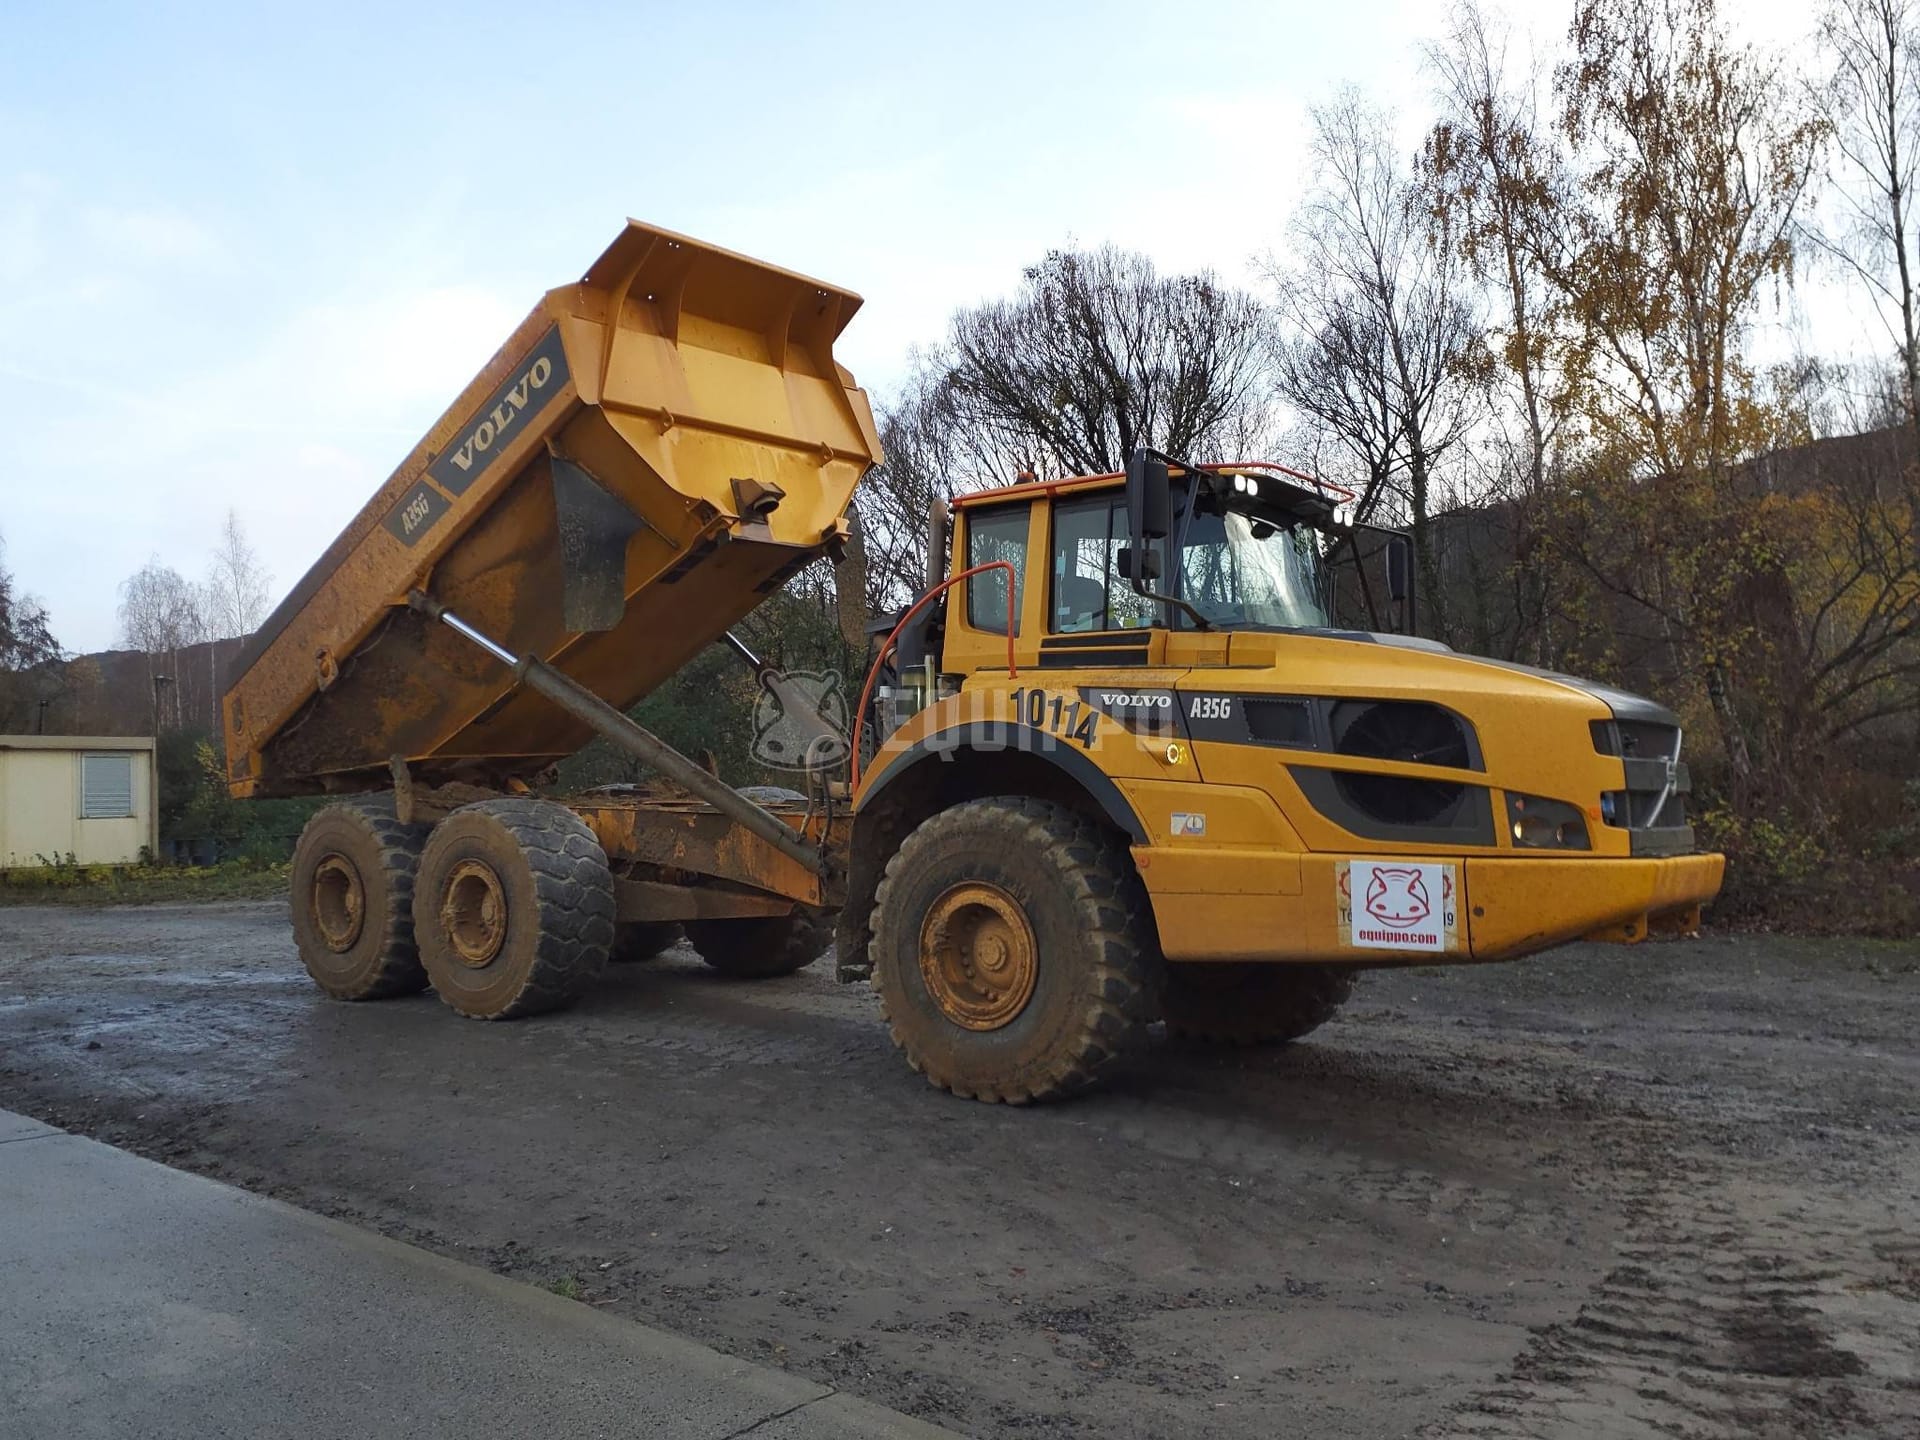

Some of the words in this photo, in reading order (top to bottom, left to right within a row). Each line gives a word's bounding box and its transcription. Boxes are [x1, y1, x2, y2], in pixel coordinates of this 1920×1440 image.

[449, 356, 553, 472] VOLVO
[401, 492, 430, 535] A35G
[1101, 694, 1172, 708] VOLVO
[1190, 697, 1231, 719] A35G
[1010, 687, 1099, 749] 10114
[1358, 929, 1438, 945] equippo.com
